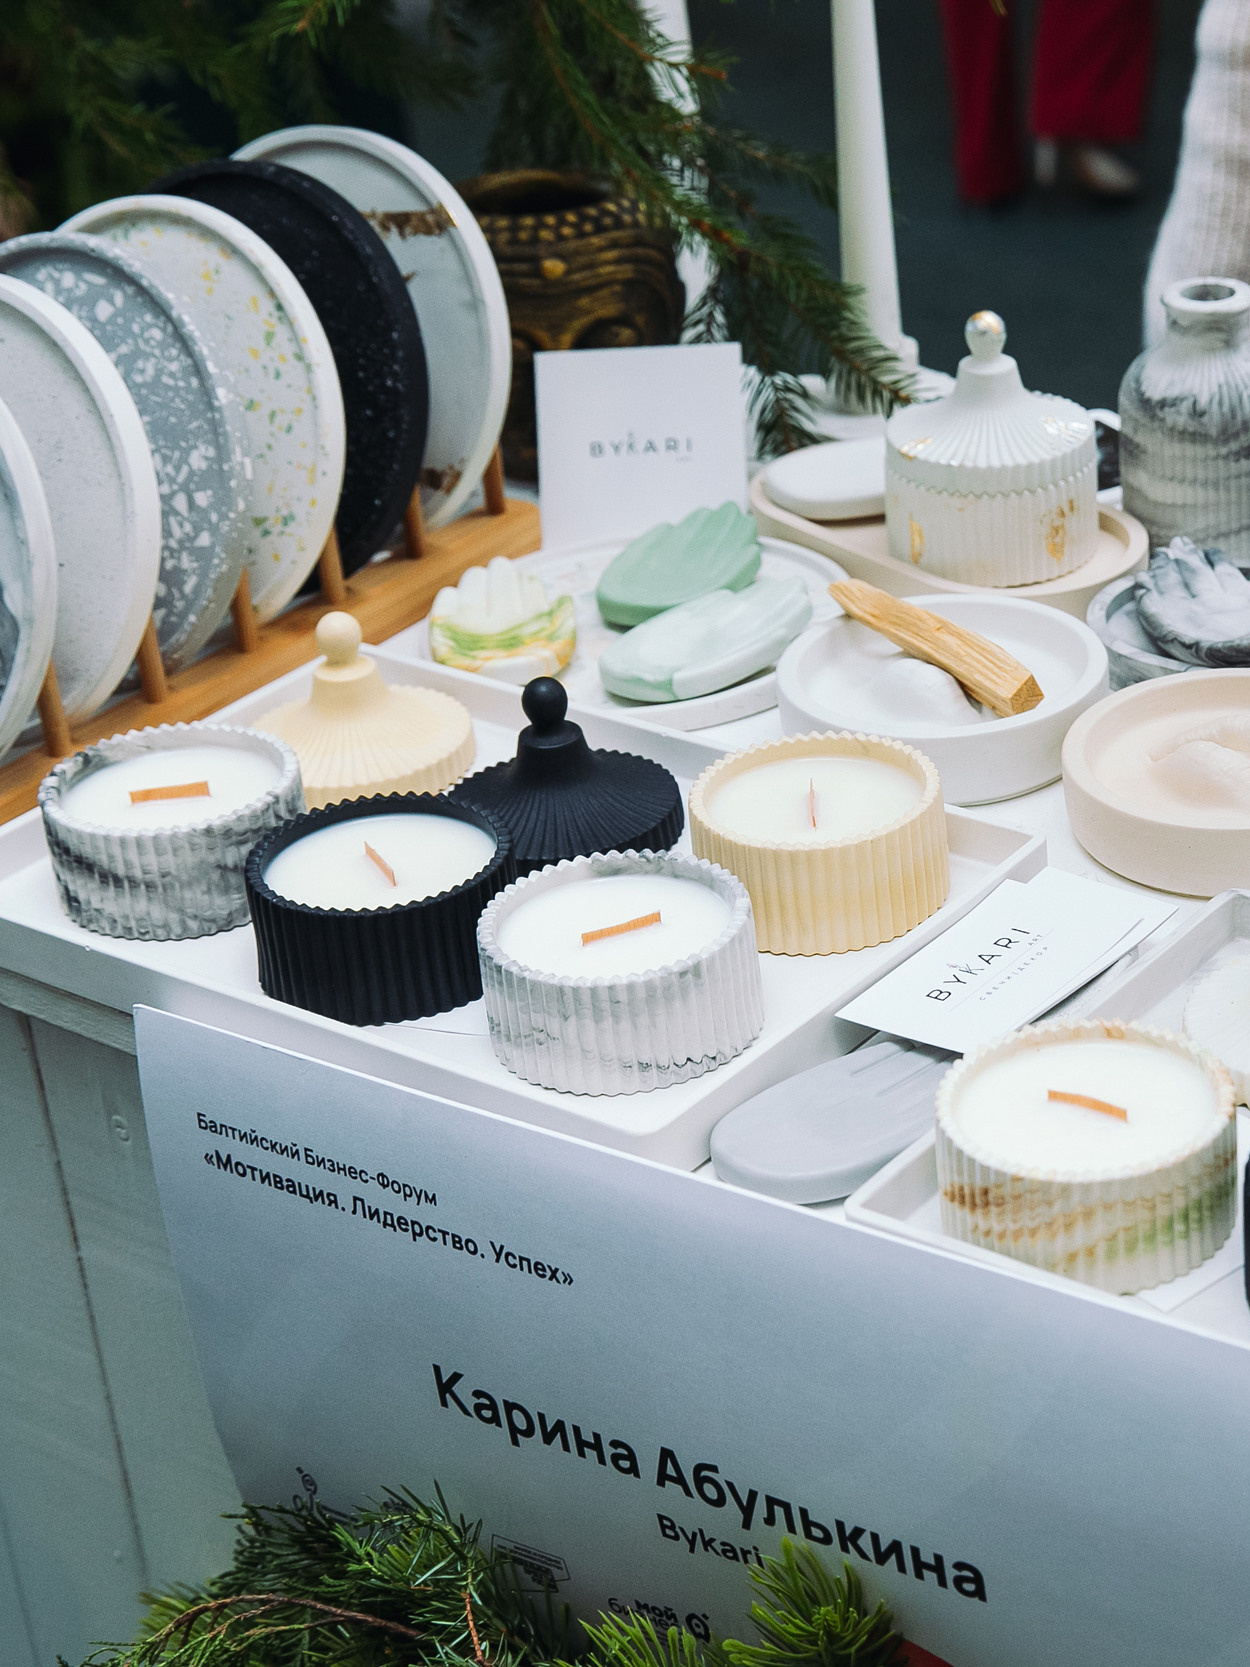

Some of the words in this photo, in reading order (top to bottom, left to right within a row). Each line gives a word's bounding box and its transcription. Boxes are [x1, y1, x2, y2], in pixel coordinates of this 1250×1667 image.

[926, 928, 1030, 1001] BYKARI
[196, 1111, 301, 1162] Балтийский
[303, 1146, 438, 1207] Бизнес-Форум
[203, 1149, 346, 1212] «Мотивация.
[351, 1195, 486, 1260] Лидерство.
[489, 1240, 574, 1287] Успех»
[431, 1362, 642, 1480] Карина
[655, 1445, 988, 1604] Абулькина
[656, 1512, 765, 1570] Bykari
[634, 1599, 679, 1624] мой
